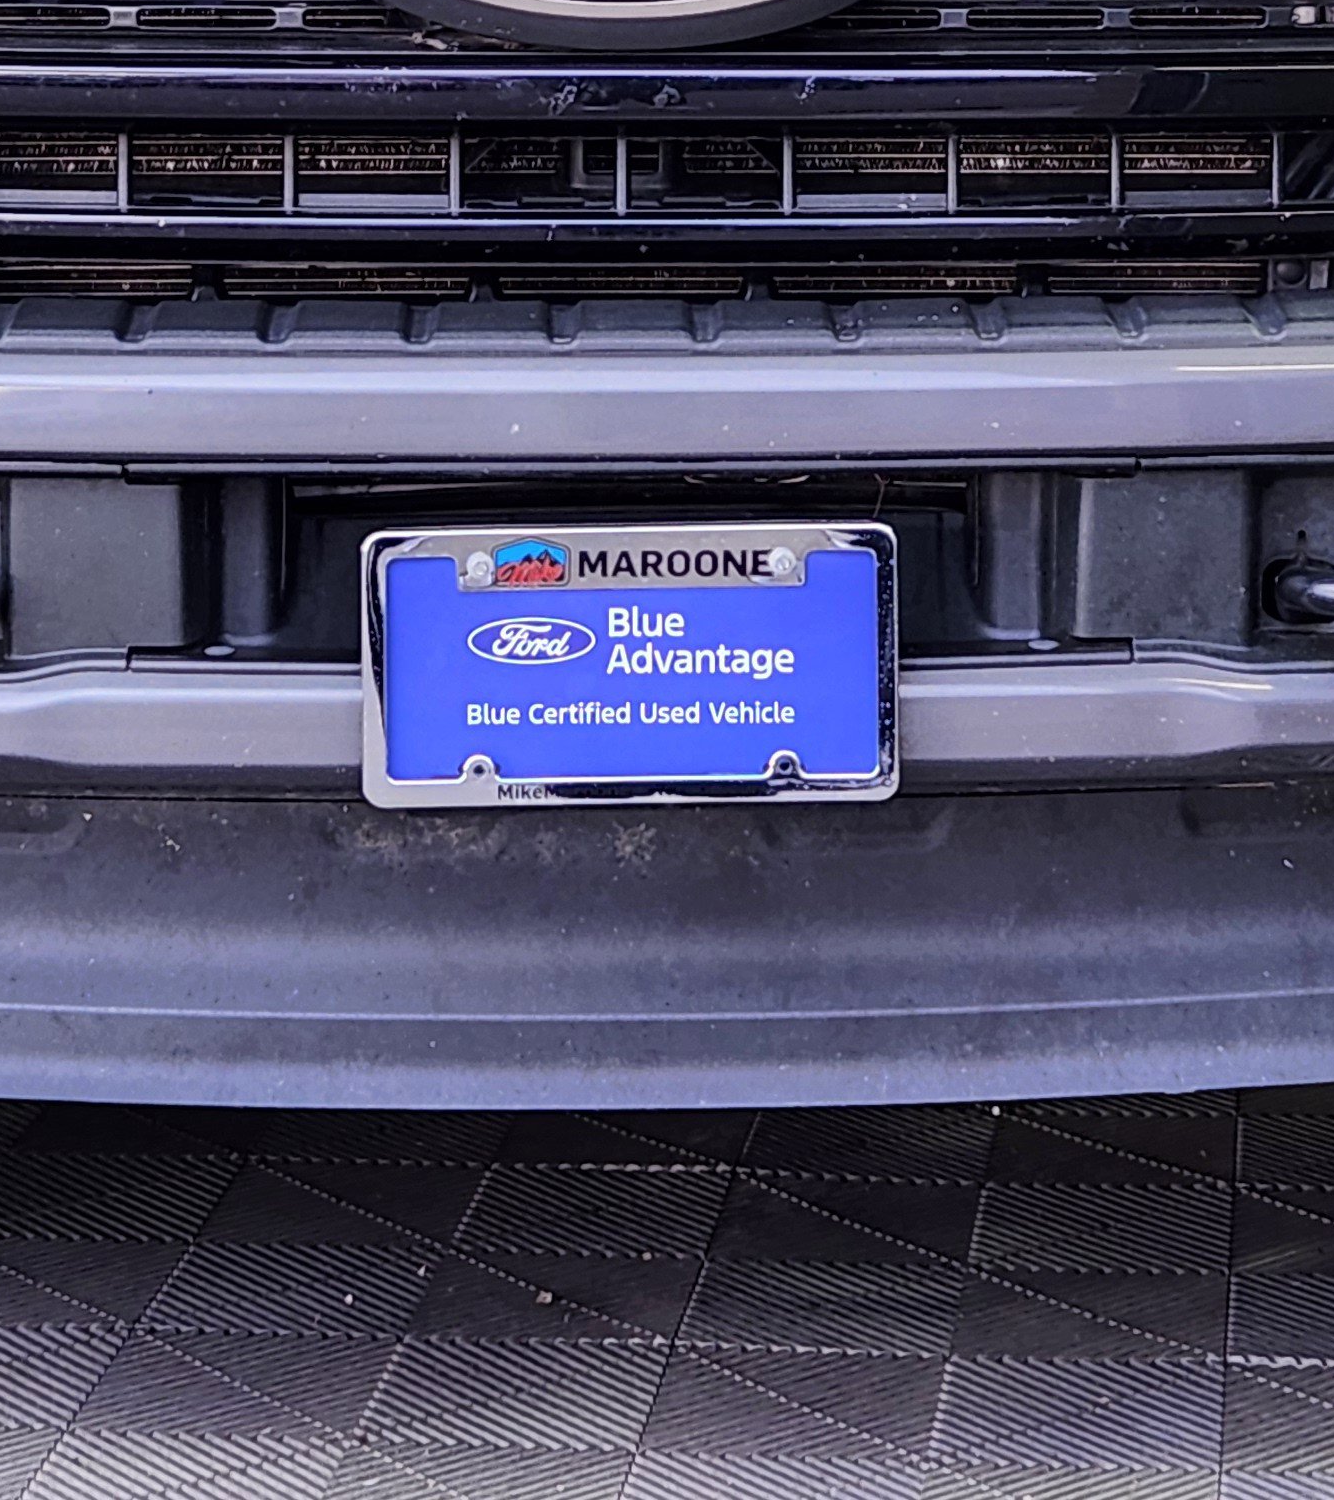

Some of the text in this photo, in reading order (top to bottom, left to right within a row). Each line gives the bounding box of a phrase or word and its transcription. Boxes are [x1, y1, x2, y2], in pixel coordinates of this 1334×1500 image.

[578, 549, 774, 577] MAROONE
[607, 606, 684, 638] Blue
[492, 625, 569, 657] Ford
[607, 642, 794, 679] Advantage
[467, 701, 795, 725] Blue Certified Used Vehicle
